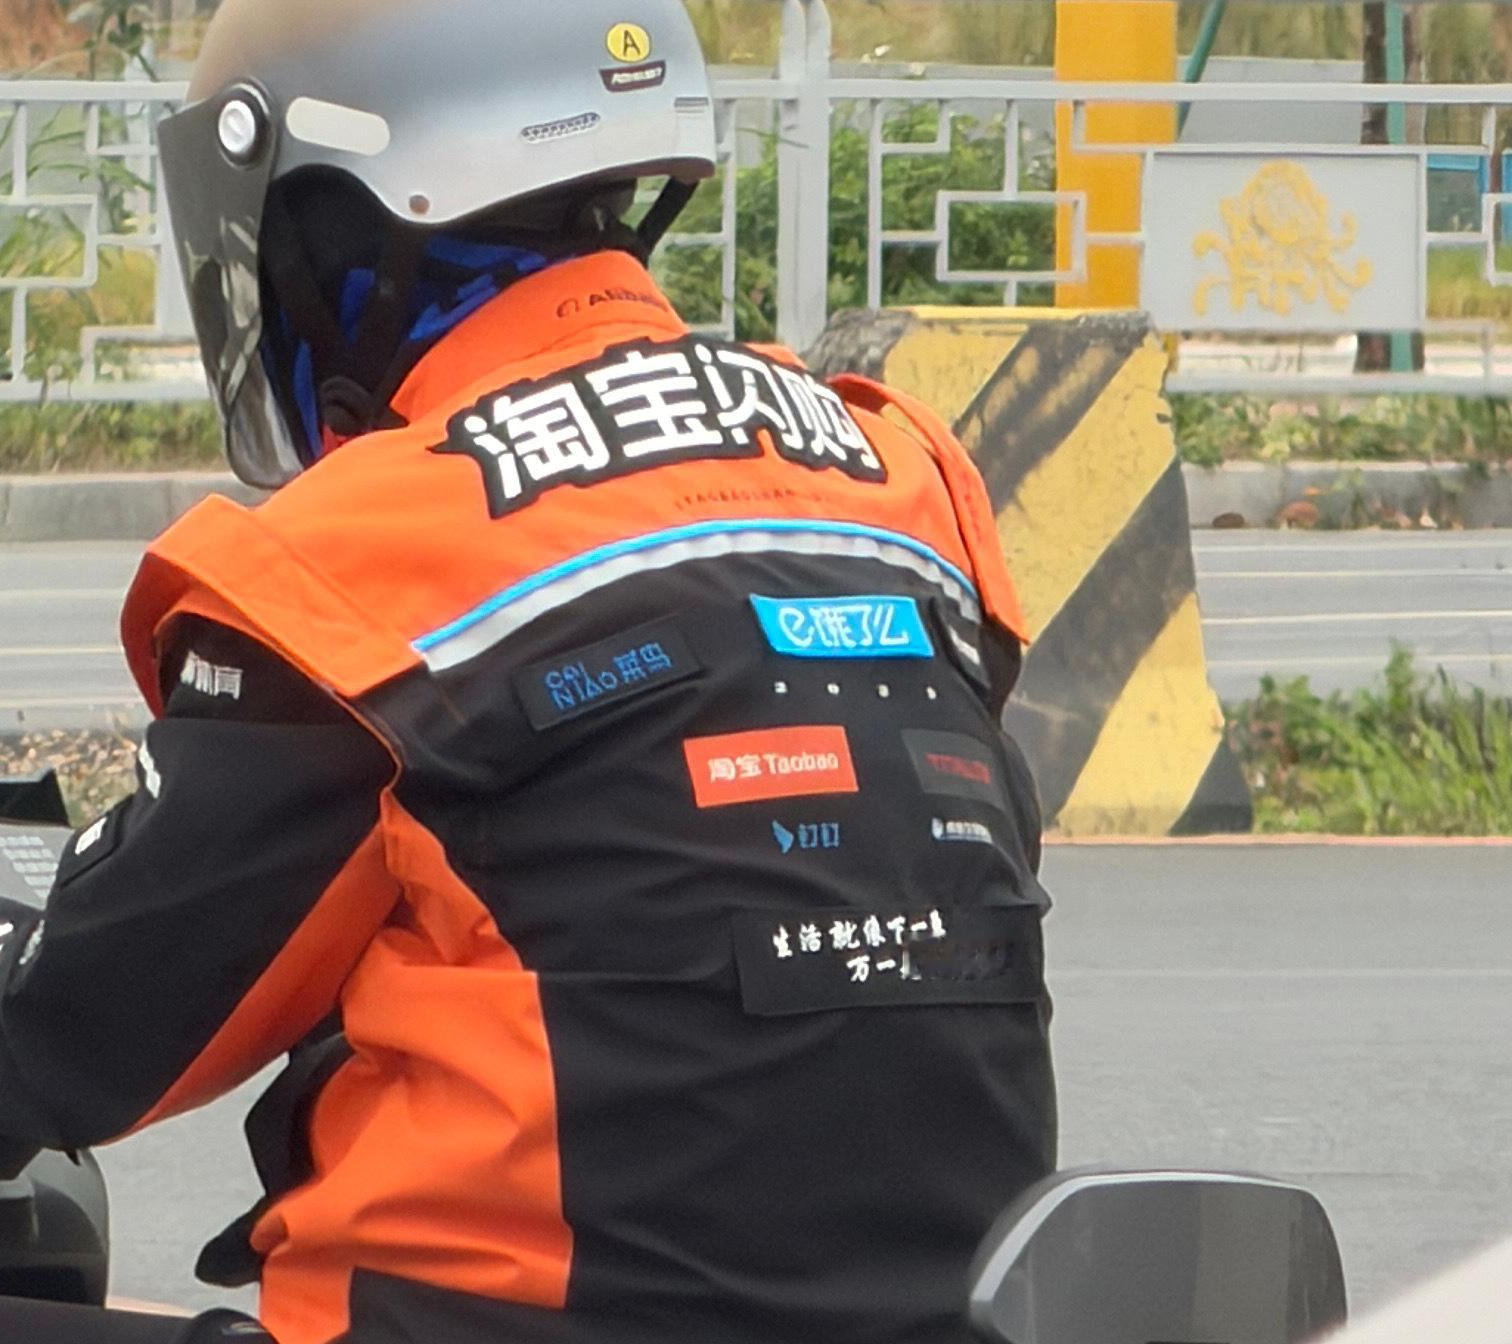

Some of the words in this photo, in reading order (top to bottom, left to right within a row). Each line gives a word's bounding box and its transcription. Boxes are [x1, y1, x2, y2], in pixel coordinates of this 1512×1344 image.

[622, 29, 641, 57] A
[464, 343, 881, 499] 淘宝闪购
[707, 754, 762, 783] 淘宝
[763, 751, 838, 774] Taobao
